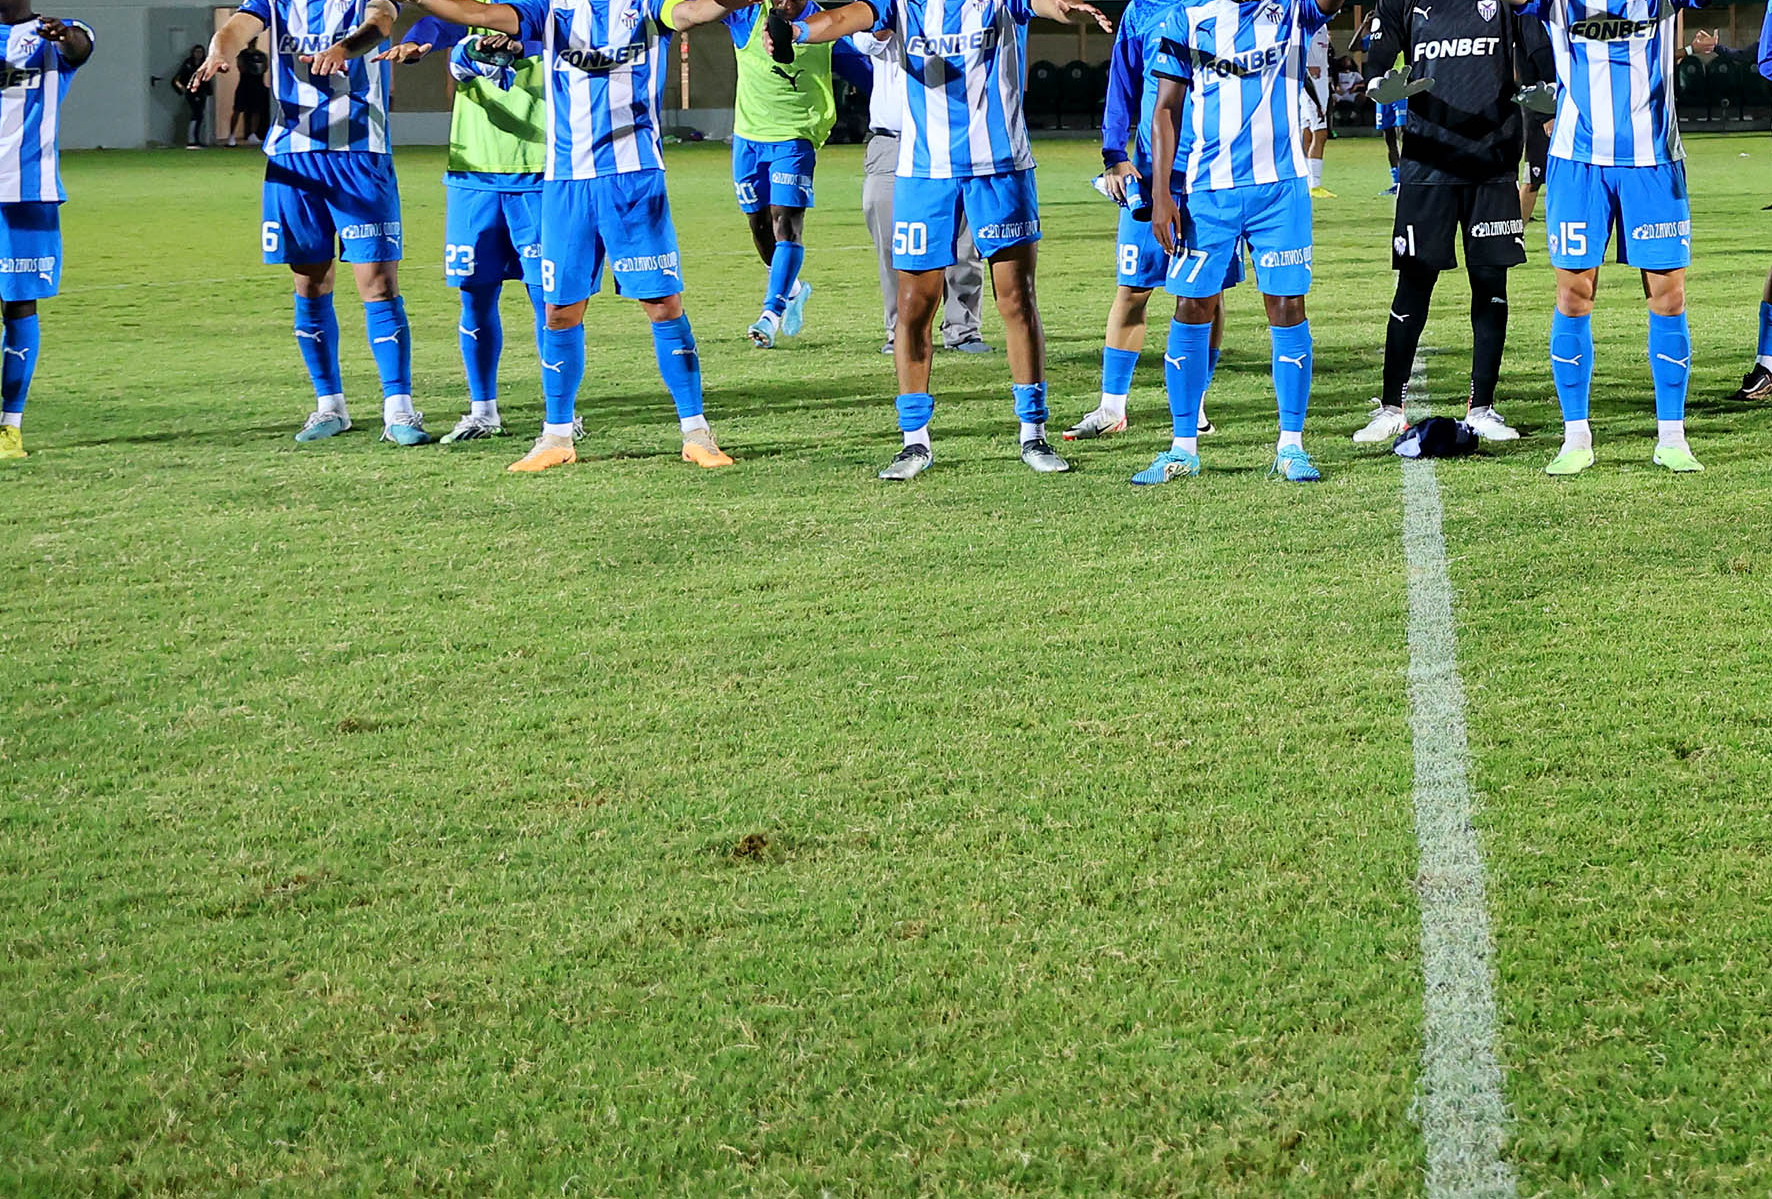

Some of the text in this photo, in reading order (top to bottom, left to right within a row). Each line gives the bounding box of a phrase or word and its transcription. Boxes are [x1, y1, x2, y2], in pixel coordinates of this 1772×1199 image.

[908, 29, 996, 56] FONBET
[1571, 20, 1659, 41] FONBET
[557, 43, 645, 69] FONBET
[1413, 37, 1500, 62] FONBET
[262, 221, 280, 252] 6
[894, 221, 927, 255] 50
[1406, 224, 1416, 256] 1
[1559, 221, 1587, 256] 15
[445, 244, 475, 276] 23
[541, 259, 556, 292] 8
